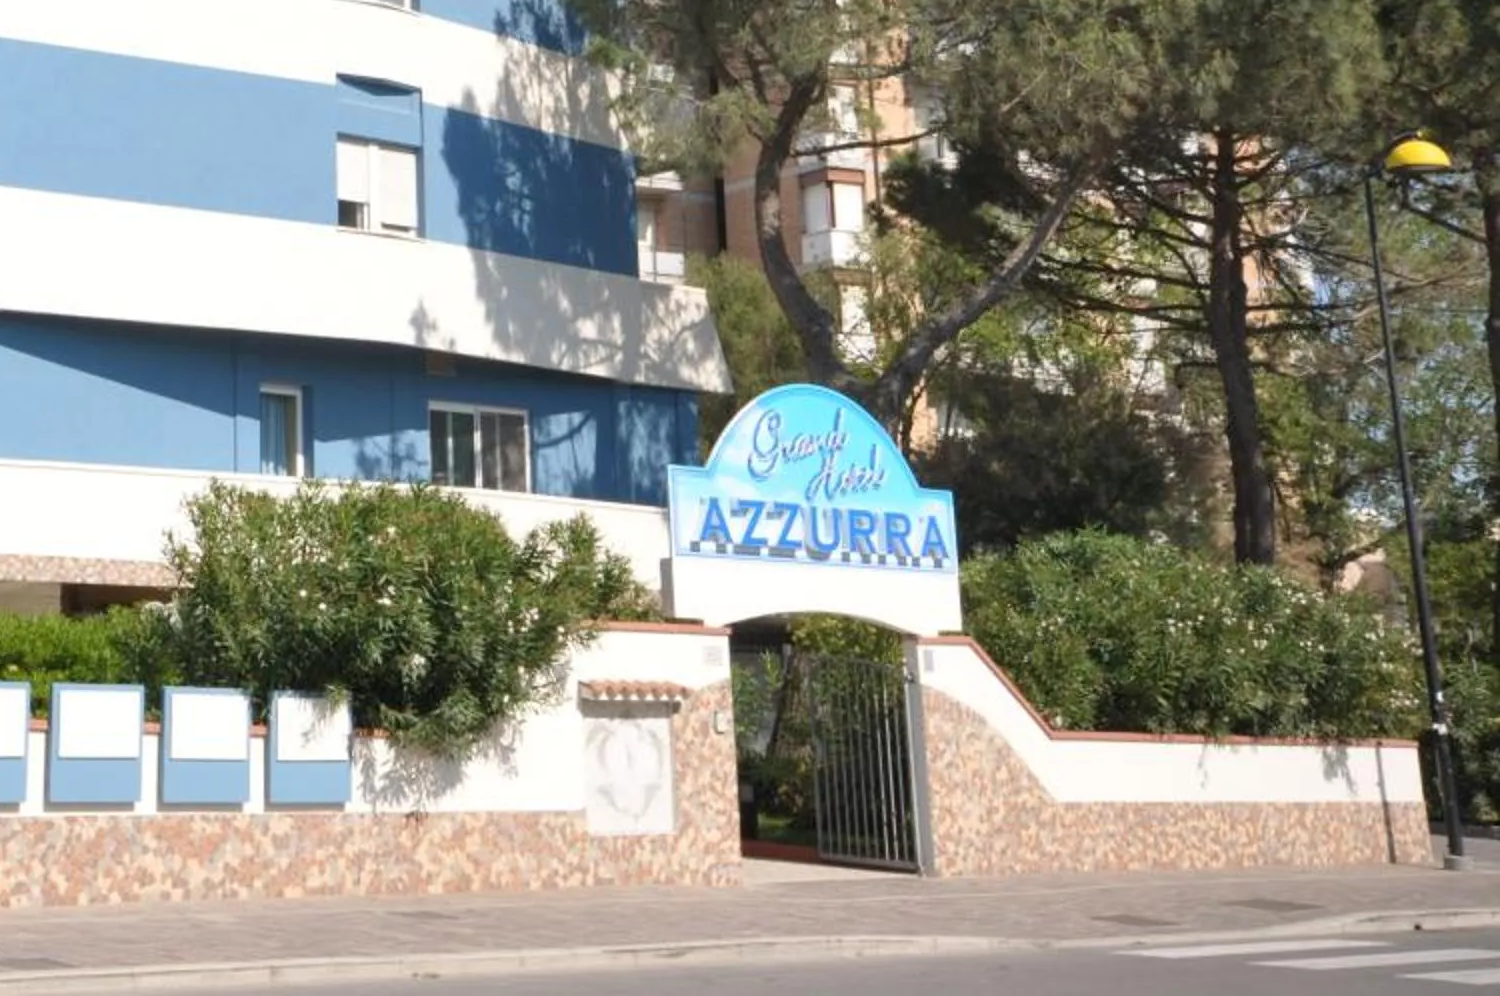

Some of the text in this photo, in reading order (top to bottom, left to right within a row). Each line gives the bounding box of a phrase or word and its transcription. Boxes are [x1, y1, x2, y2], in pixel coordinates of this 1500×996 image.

[747, 408, 847, 482] Grand
[804, 443, 885, 502] Hotel
[699, 496, 949, 558] AZZURRA
